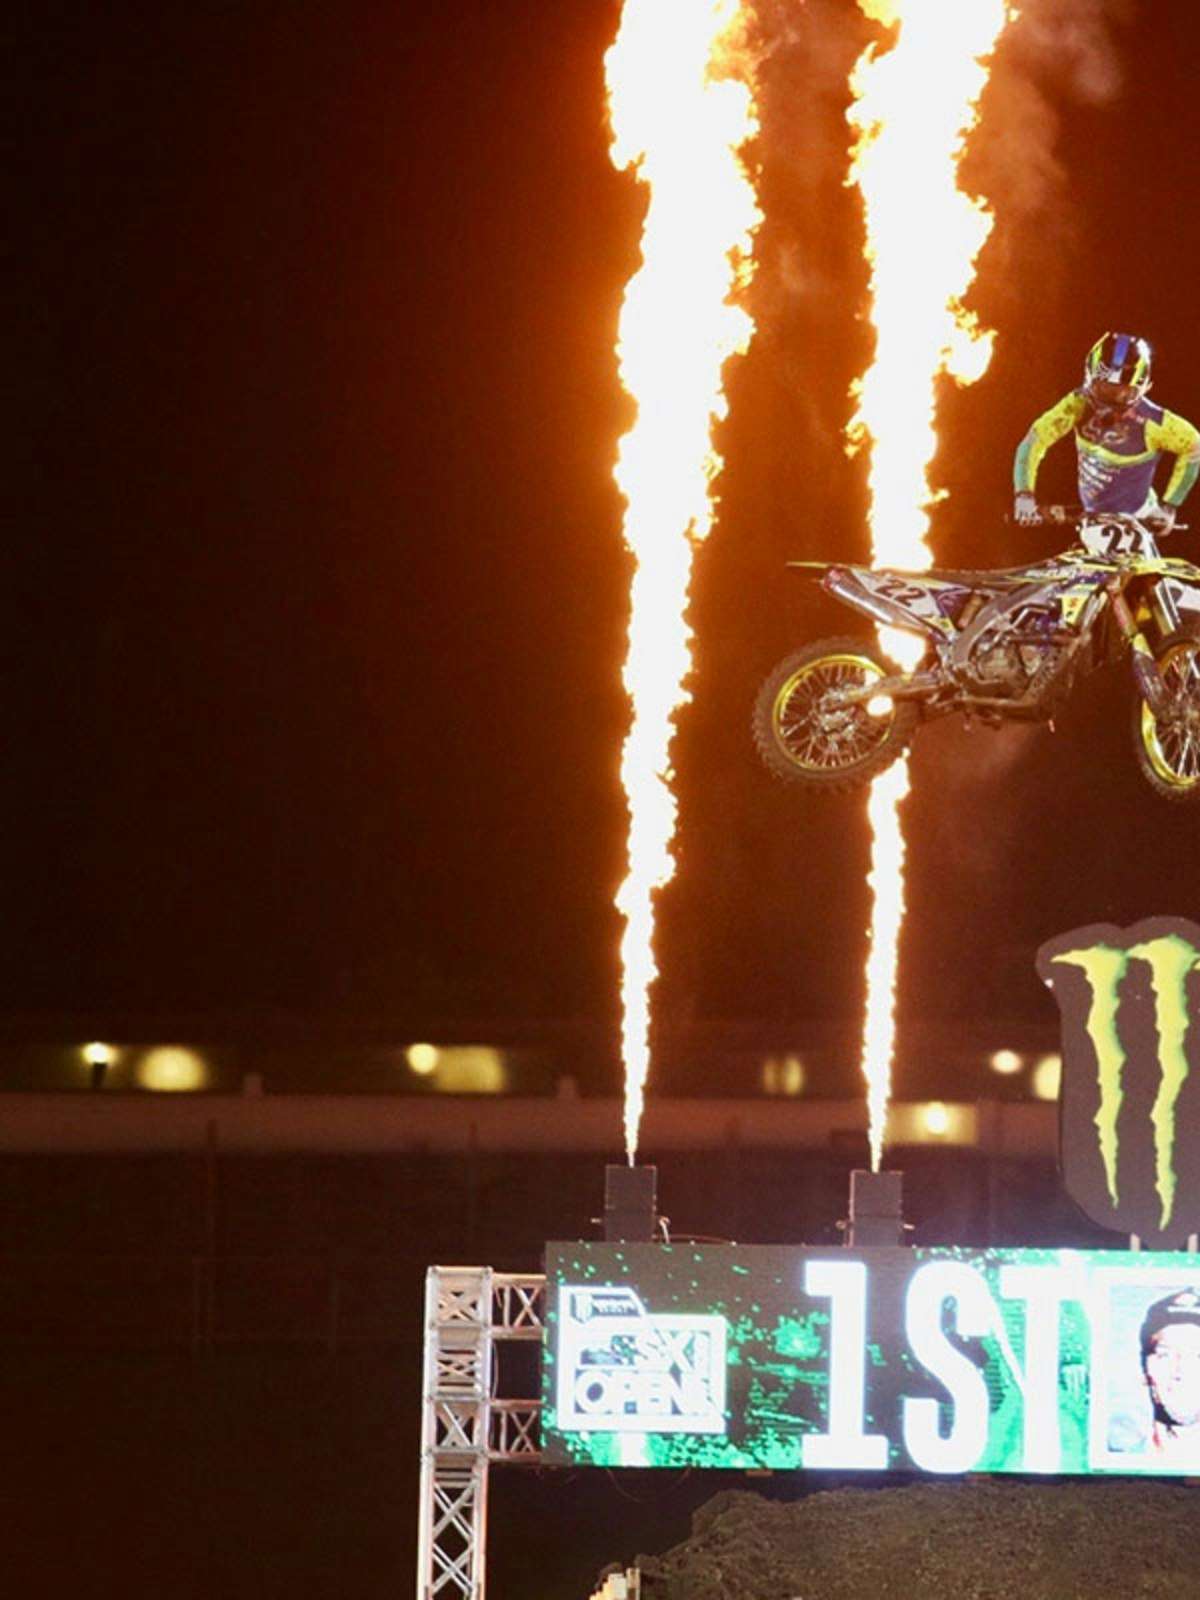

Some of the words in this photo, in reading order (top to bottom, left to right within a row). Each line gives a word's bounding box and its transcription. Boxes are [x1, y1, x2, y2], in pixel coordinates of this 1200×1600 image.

[1101, 524, 1146, 554] 22
[874, 578, 928, 608] 22
[801, 1260, 1086, 1475] 1ST
